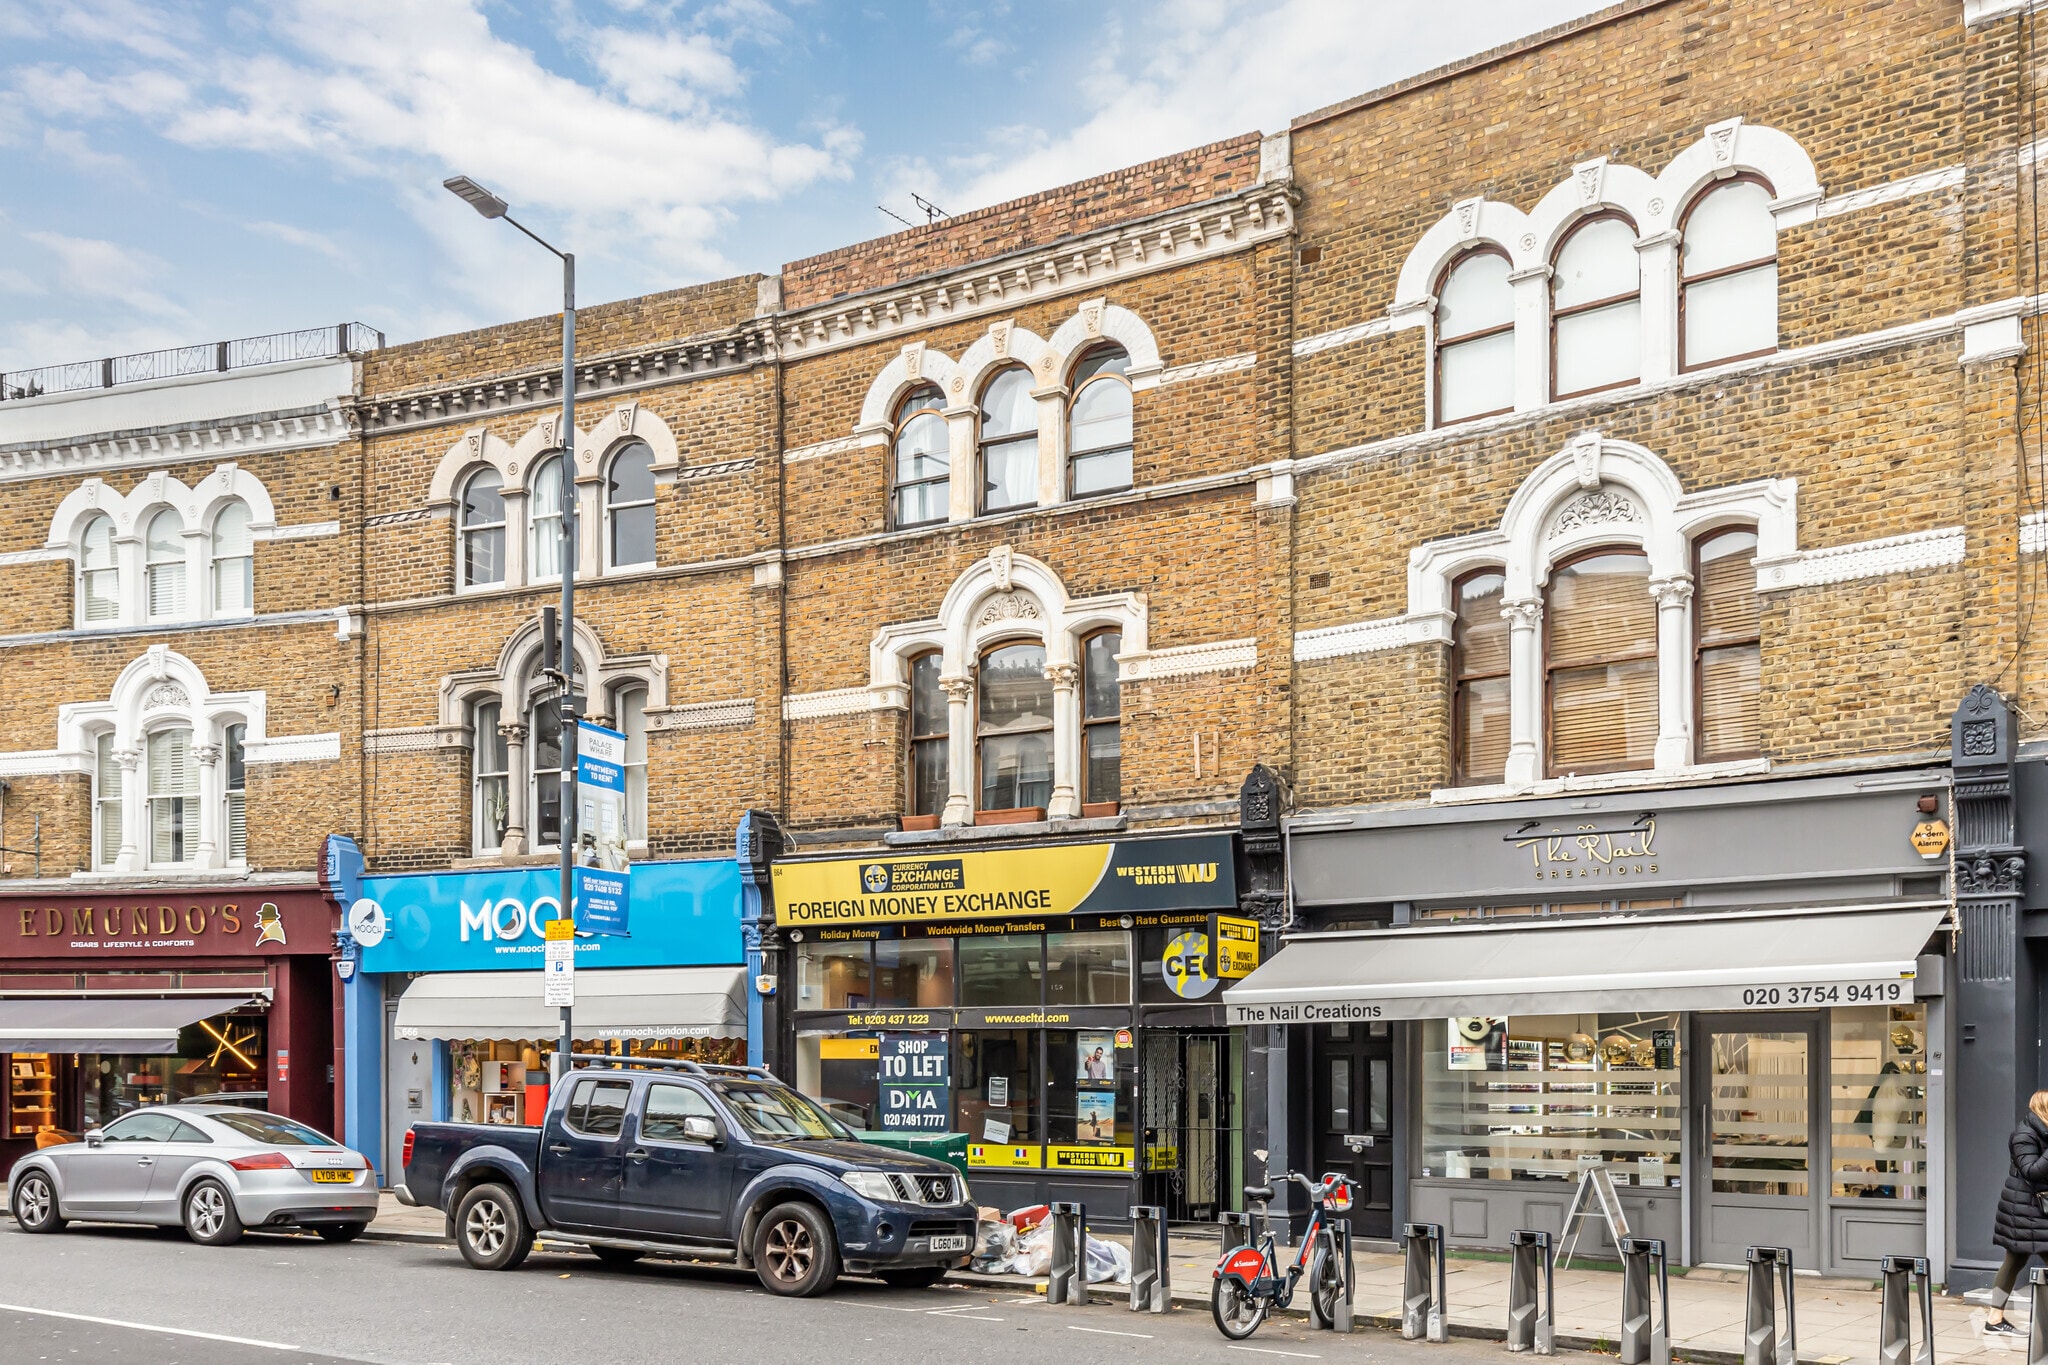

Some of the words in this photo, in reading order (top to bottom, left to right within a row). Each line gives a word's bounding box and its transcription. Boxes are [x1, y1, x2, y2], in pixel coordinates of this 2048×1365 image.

[589, 737, 613, 749] PALACE
[589, 746, 613, 757] WHARF
[584, 762, 618, 778] APARTMENTS
[590, 771, 598, 780] TO
[598, 773, 613, 783] RENT
[1915, 830, 1944, 839] Modern
[1515, 828, 1577, 867] The
[1581, 819, 1657, 864] Nail
[892, 862, 929, 872] CURRENCY
[1116, 865, 1175, 877] WESTERN
[1536, 863, 1658, 880] CREATIONS
[891, 868, 960, 883] EXCHANGE
[1181, 863, 1217, 883] WU
[866, 874, 886, 884] CEC
[1135, 874, 1176, 885] UNION
[607, 886, 622, 895] 5132
[891, 882, 940, 892] CORPORATION
[788, 899, 866, 920] FOREIGN
[870, 895, 938, 916] MONEY
[944, 889, 1052, 913] EXCHANGE
[18, 904, 242, 936] EDMUNDO'S
[1100, 918, 1120, 928] Best
[1136, 915, 1158, 926] Rate
[354, 924, 382, 935] MOOCH
[927, 925, 973, 936] Worldwide
[975, 924, 1005, 935] Money
[1005, 921, 1046, 932] Transfers
[1220, 923, 1241, 932] WESTERN
[820, 930, 851, 940] Holiday
[852, 929, 880, 939] Money
[1226, 931, 1241, 939] UNION
[103, 940, 143, 948] LIFESTYLE
[152, 939, 195, 947] COMFORTS
[1220, 955, 1231, 964] CEC
[1236, 951, 1253, 962] MONEY
[557, 962, 563, 971] P
[1232, 961, 1257, 972] EXCHANGE
[1743, 987, 1780, 1006] 020
[1787, 985, 1840, 1003] 3754
[1846, 983, 1901, 1002] 9419
[1236, 1007, 1265, 1021] The
[1270, 1006, 1299, 1020] Nail
[1304, 1003, 1382, 1019] Creations
[848, 1015, 863, 1025] Tel:
[864, 1015, 886, 1025] 0203
[888, 1015, 905, 1024] 437
[908, 1014, 929, 1024] 1223
[985, 1013, 1069, 1024] www.cecltd.com
[402, 1027, 418, 1036] 666
[598, 1026, 710, 1037] www.mooch-london.com
[898, 1040, 929, 1054] SHOP
[1656, 1038, 1673, 1047] OPEN
[883, 1055, 907, 1077] TO
[913, 1055, 944, 1077] LET
[890, 1090, 937, 1109] DMA
[884, 1114, 900, 1126] 020
[901, 1114, 921, 1126] 7491
[923, 1114, 945, 1126] 7777
[1098, 1153, 1120, 1166] WU
[315, 1171, 336, 1180] LY08
[337, 1171, 352, 1180] HMC
[933, 1237, 951, 1250] LG60
[1238, 1259, 1259, 1267] Santander
